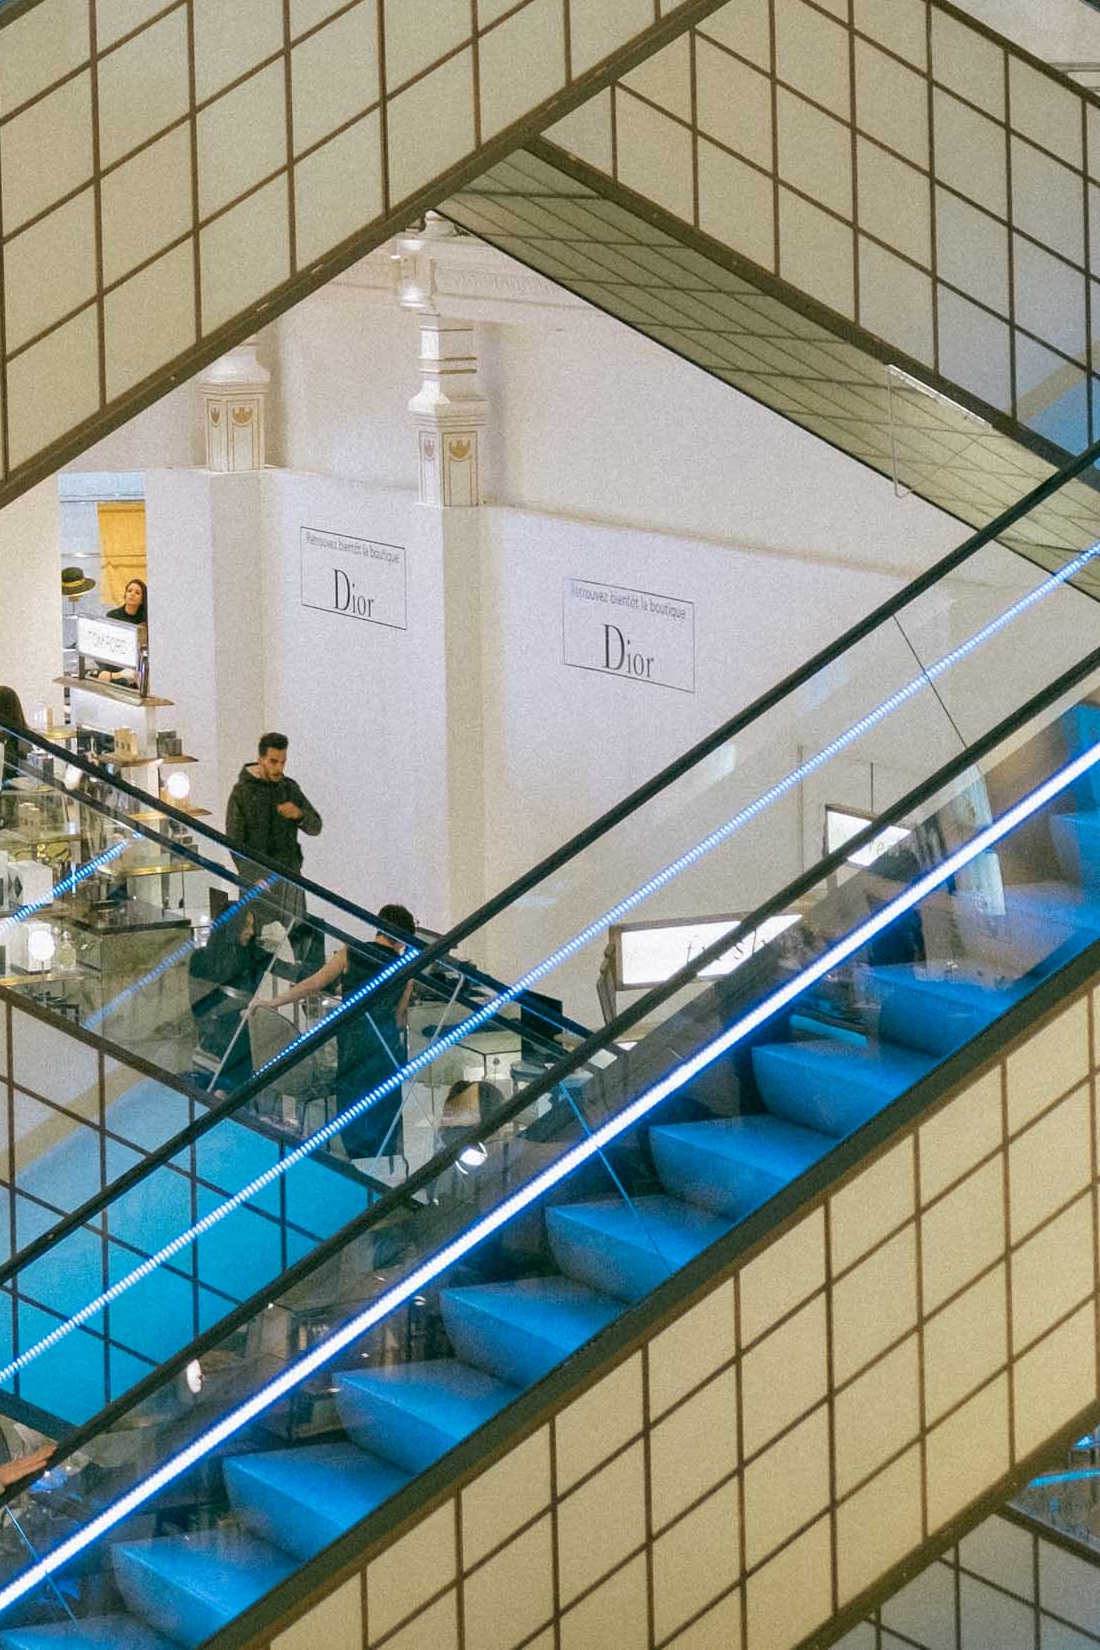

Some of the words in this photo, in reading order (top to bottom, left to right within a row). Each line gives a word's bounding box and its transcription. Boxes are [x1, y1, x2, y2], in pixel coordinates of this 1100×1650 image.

[333, 569, 374, 617] Dior
[649, 599, 686, 622] boutique
[602, 624, 654, 678] Dior
